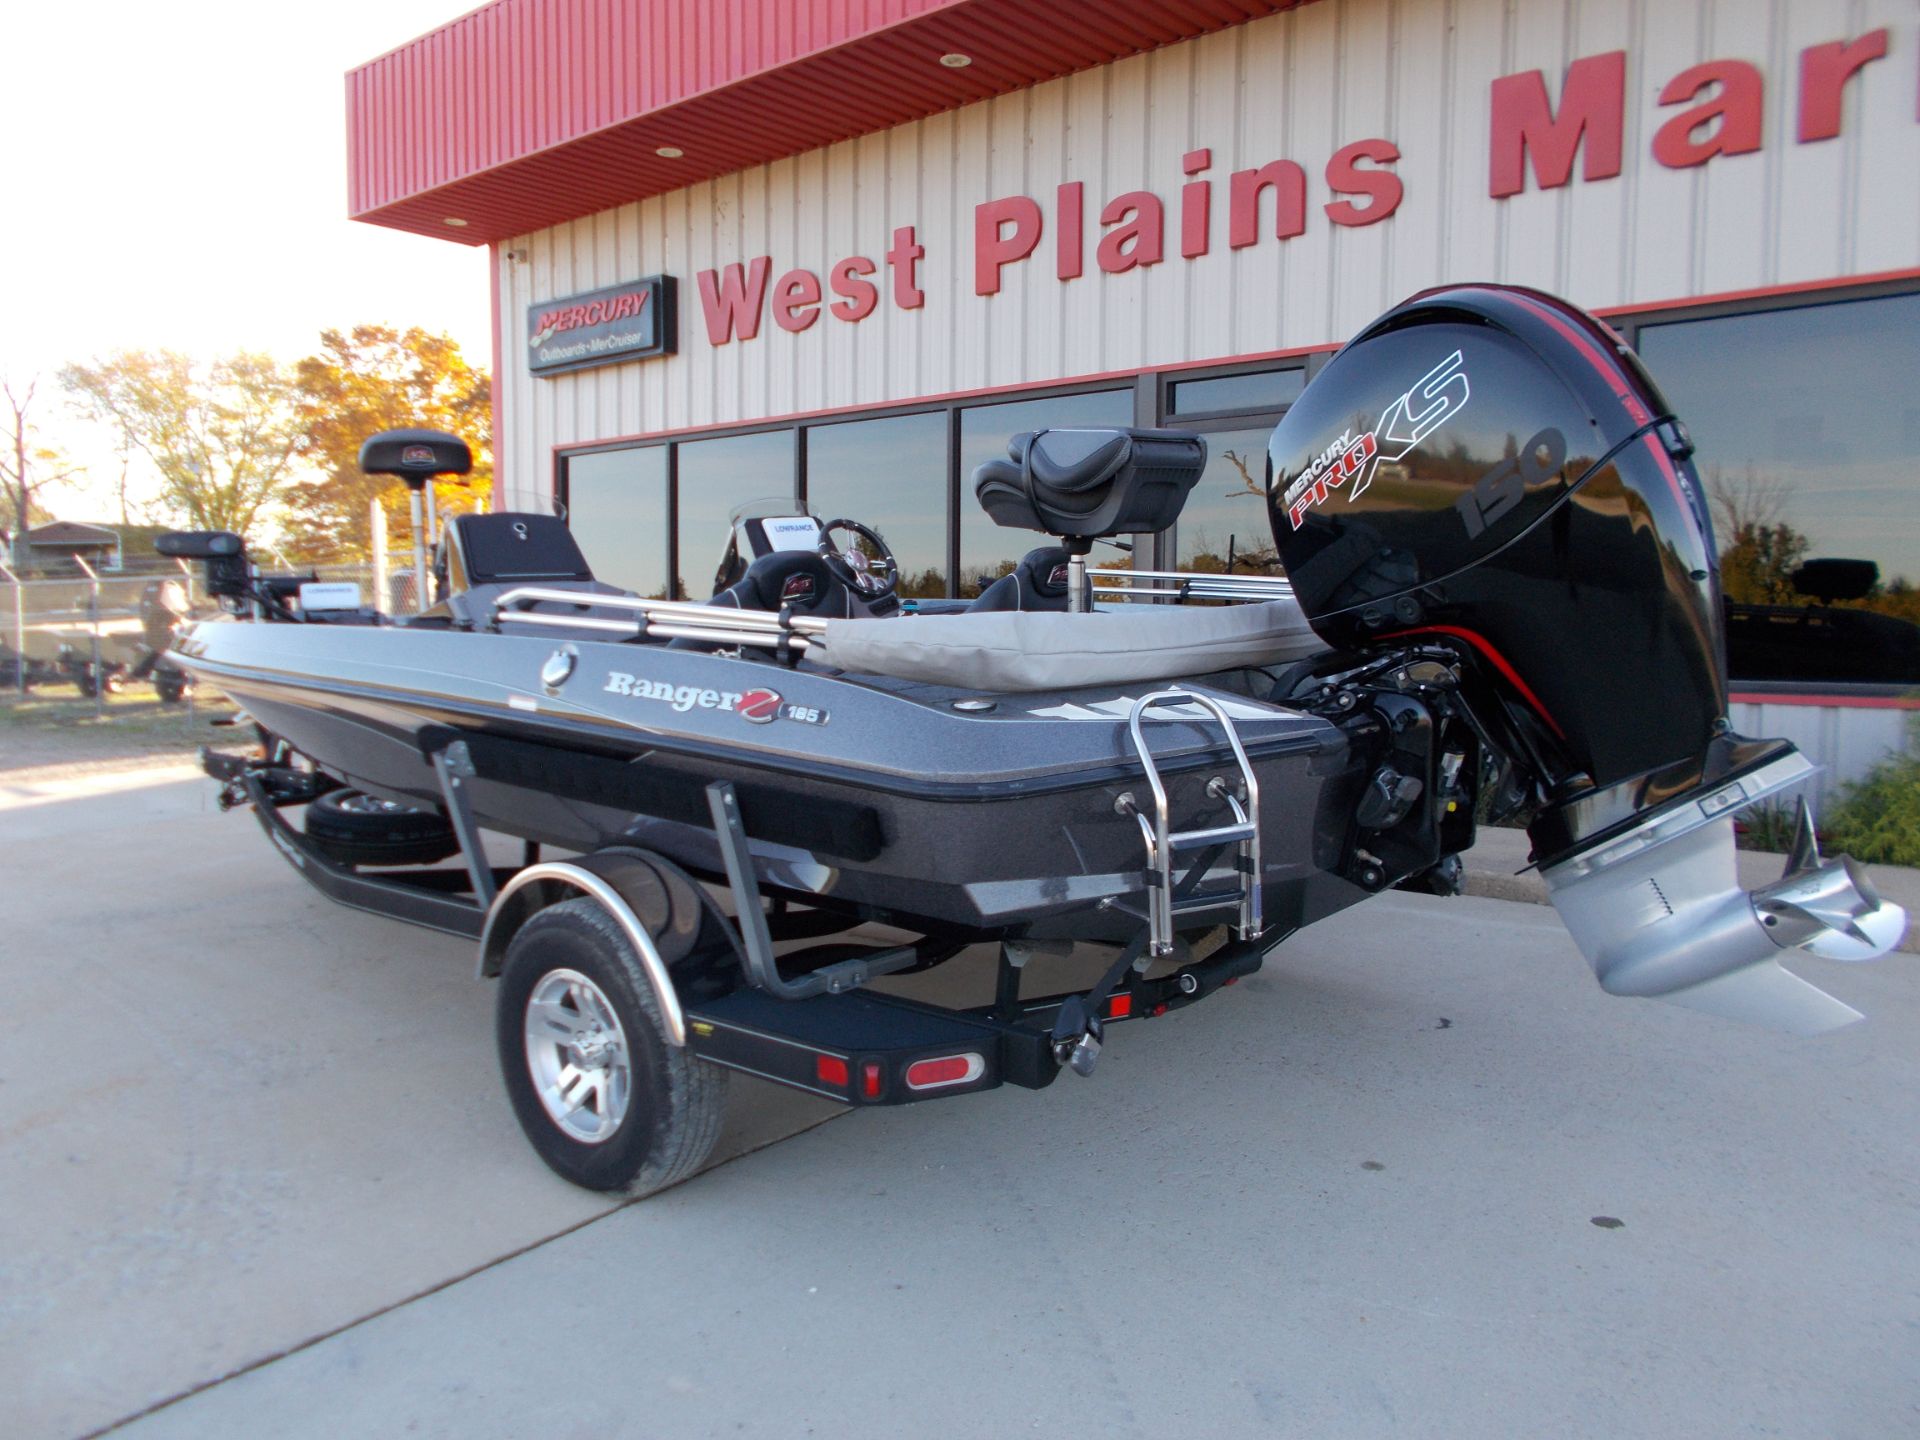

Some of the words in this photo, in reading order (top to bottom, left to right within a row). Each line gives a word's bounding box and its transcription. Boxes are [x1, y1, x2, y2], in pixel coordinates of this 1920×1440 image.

[696, 225, 925, 345] West
[974, 138, 1404, 297] Plains
[1489, 24, 1920, 200] Mar
[535, 288, 649, 337] MERCURY
[1284, 428, 1355, 504] MERCURY
[1288, 431, 1378, 532] PRO
[1456, 426, 1568, 540] 150
[603, 671, 743, 712] Ranger
[787, 705, 819, 722] 185
